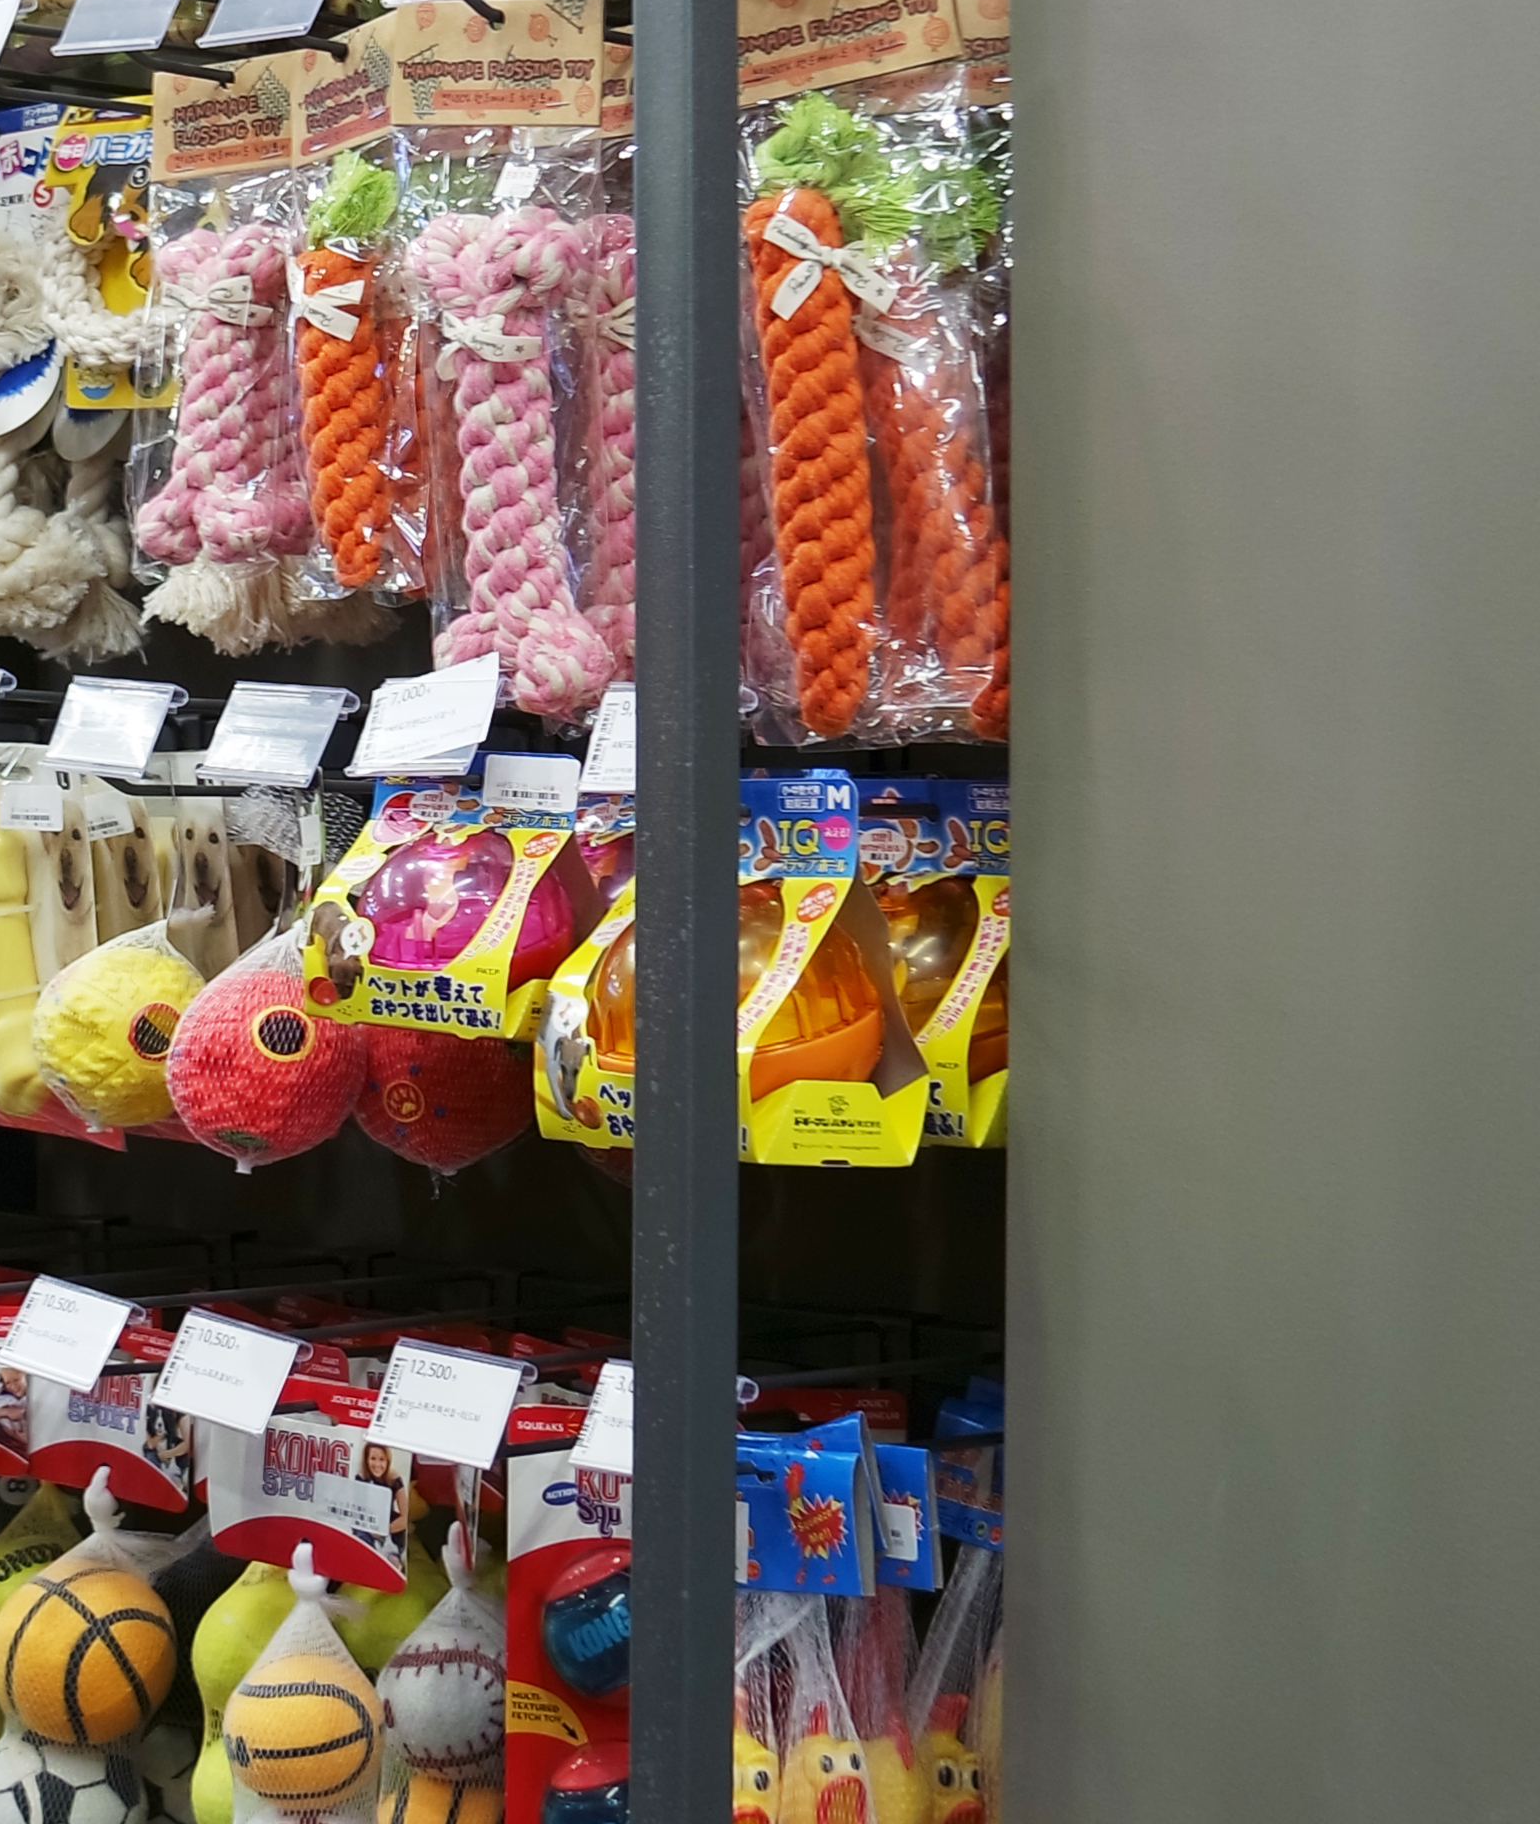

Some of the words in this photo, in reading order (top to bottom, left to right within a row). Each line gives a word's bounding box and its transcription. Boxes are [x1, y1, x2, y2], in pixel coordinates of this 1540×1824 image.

[738, 24, 804, 54] DMADE
[810, 0, 902, 42] FLOSSING
[963, 36, 1009, 60] SSIN
[403, 59, 484, 82] HANDMADE
[488, 59, 563, 80] FLOSSING
[564, 59, 595, 81] TOY
[173, 95, 260, 125] HANDMADE
[174, 119, 250, 147] FLOSSING
[253, 116, 283, 137] TOY
[35, 182, 53, 205] S
[826, 784, 851, 811] M
[778, 818, 820, 854] IQ
[367, 975, 485, 1006] ペットが考えて
[370, 997, 502, 1030] おやつを出して遊ぶ!
[68, 1396, 141, 1434] SPORT
[516, 1420, 564, 1432] SQUEAKS
[265, 1428, 352, 1477] KONG
[262, 1468, 315, 1502] SPO
[575, 1494, 622, 1538] Squ
[568, 1606, 631, 1662] KONG
[511, 1692, 542, 1701] MULTI-
[512, 1701, 560, 1713] TEXTURED
[511, 1711, 542, 1721] FETCH
